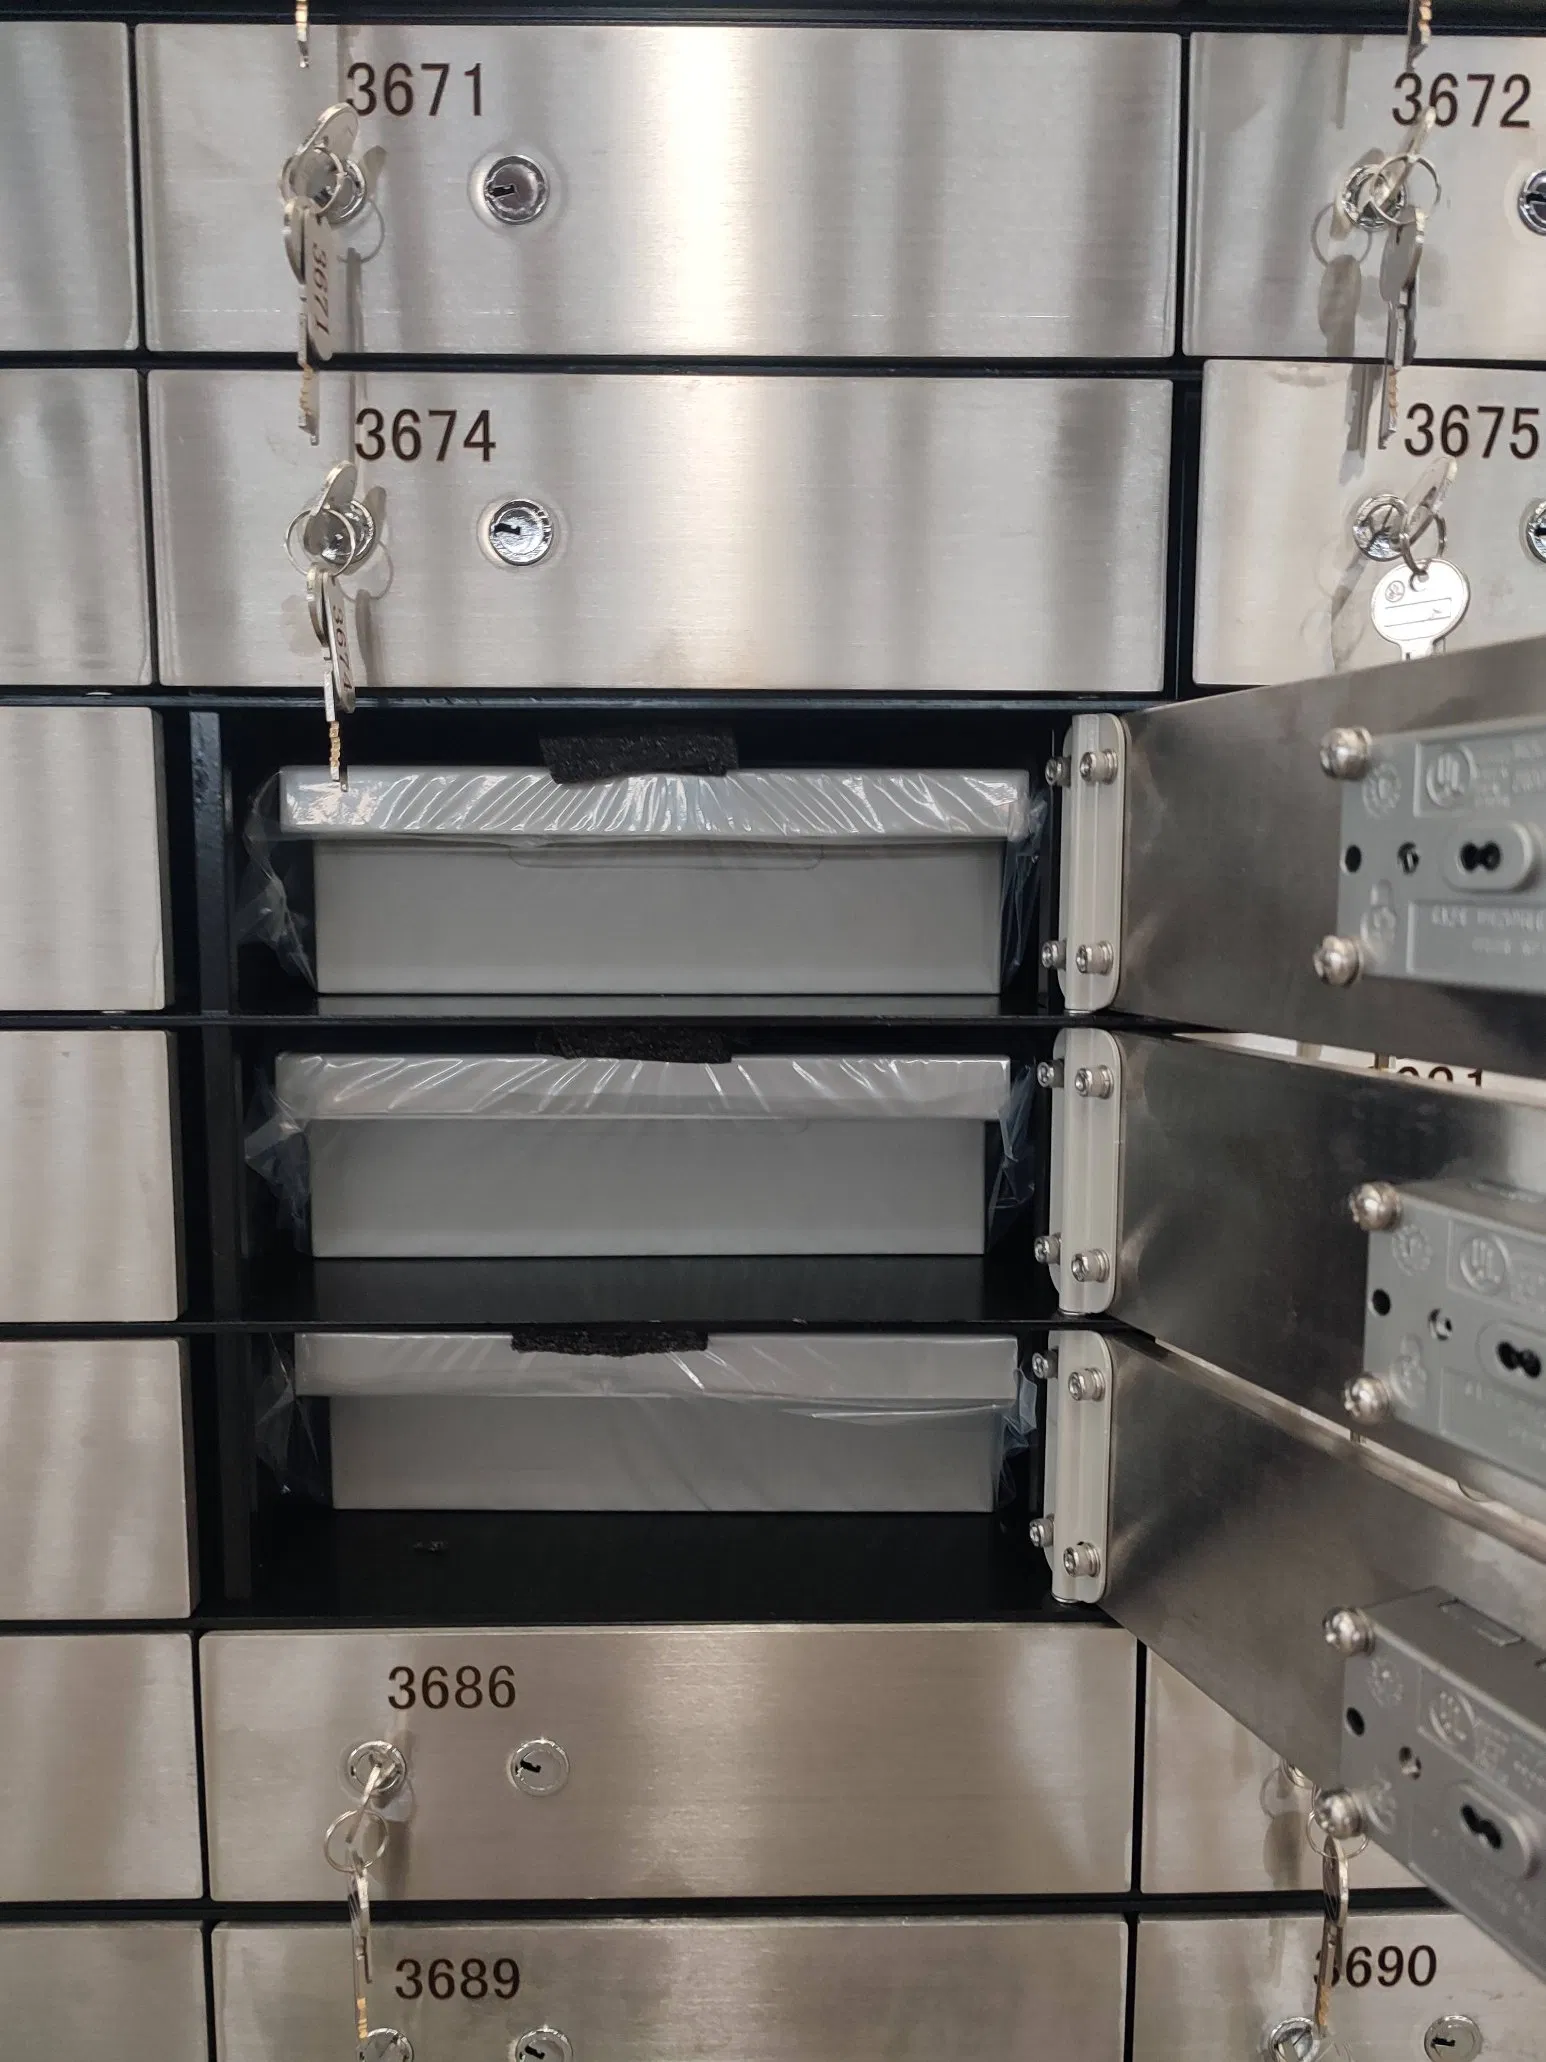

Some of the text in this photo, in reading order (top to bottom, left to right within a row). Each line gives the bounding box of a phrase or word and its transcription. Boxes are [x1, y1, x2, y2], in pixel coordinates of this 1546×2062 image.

[346, 62, 482, 116] 3671
[1391, 73, 1531, 128] 3672
[355, 408, 496, 462] 3674
[1404, 403, 1540, 459] 3675
[387, 1665, 516, 1709] 3686
[395, 1957, 521, 2000] 3689
